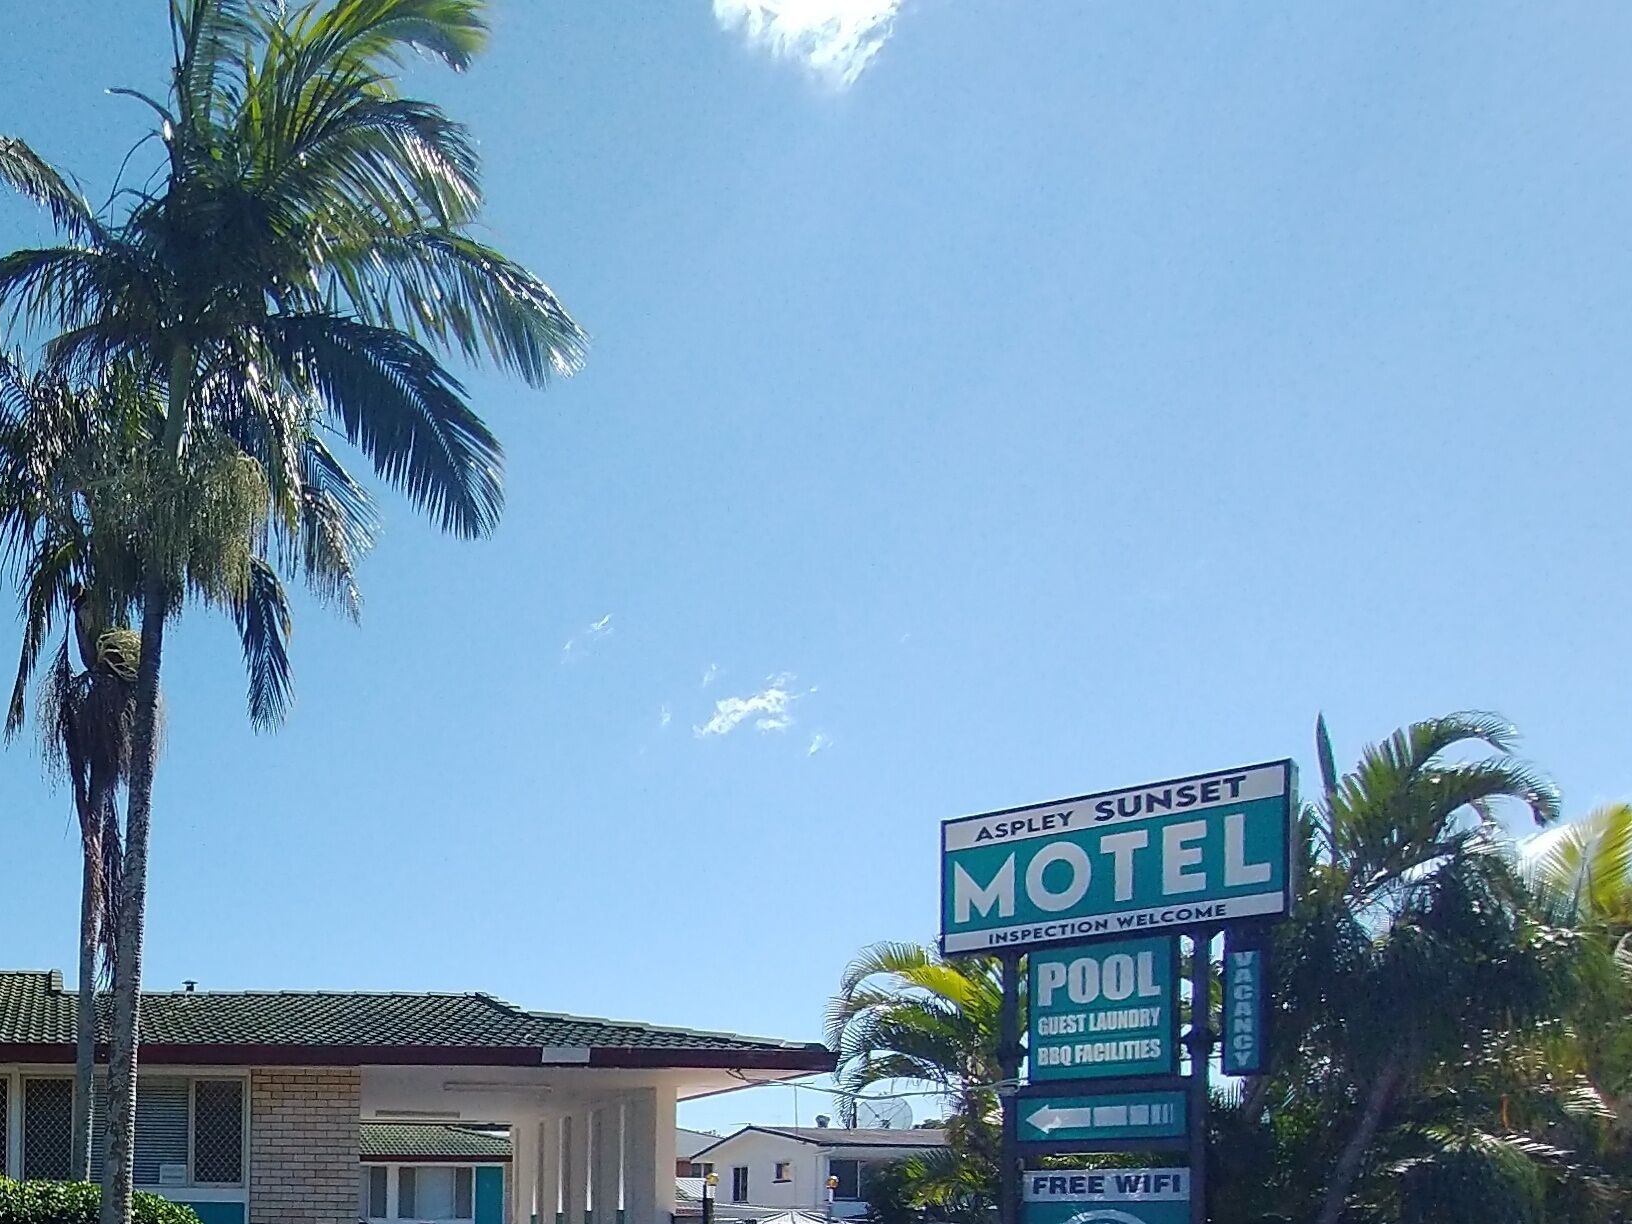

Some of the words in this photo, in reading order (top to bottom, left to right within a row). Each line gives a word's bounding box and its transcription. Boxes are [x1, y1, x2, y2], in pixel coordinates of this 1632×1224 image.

[974, 810, 1074, 843] ASPLEY
[1093, 775, 1247, 823] SUNSET
[953, 813, 1272, 924] MOTEL
[988, 918, 1109, 945] INSPECTION
[1116, 903, 1228, 929] WELCOME
[1037, 951, 1161, 1007] POOL
[1037, 1013, 1086, 1035] GUEST
[1088, 1007, 1161, 1031] LAUNDRY
[1233, 951, 1254, 1066] VACANCY
[1037, 1045, 1073, 1067] BBQ
[1074, 1038, 1161, 1063] FACILITIES
[1032, 1175, 1105, 1195] FREE
[1114, 1174, 1181, 1193] WIFI
